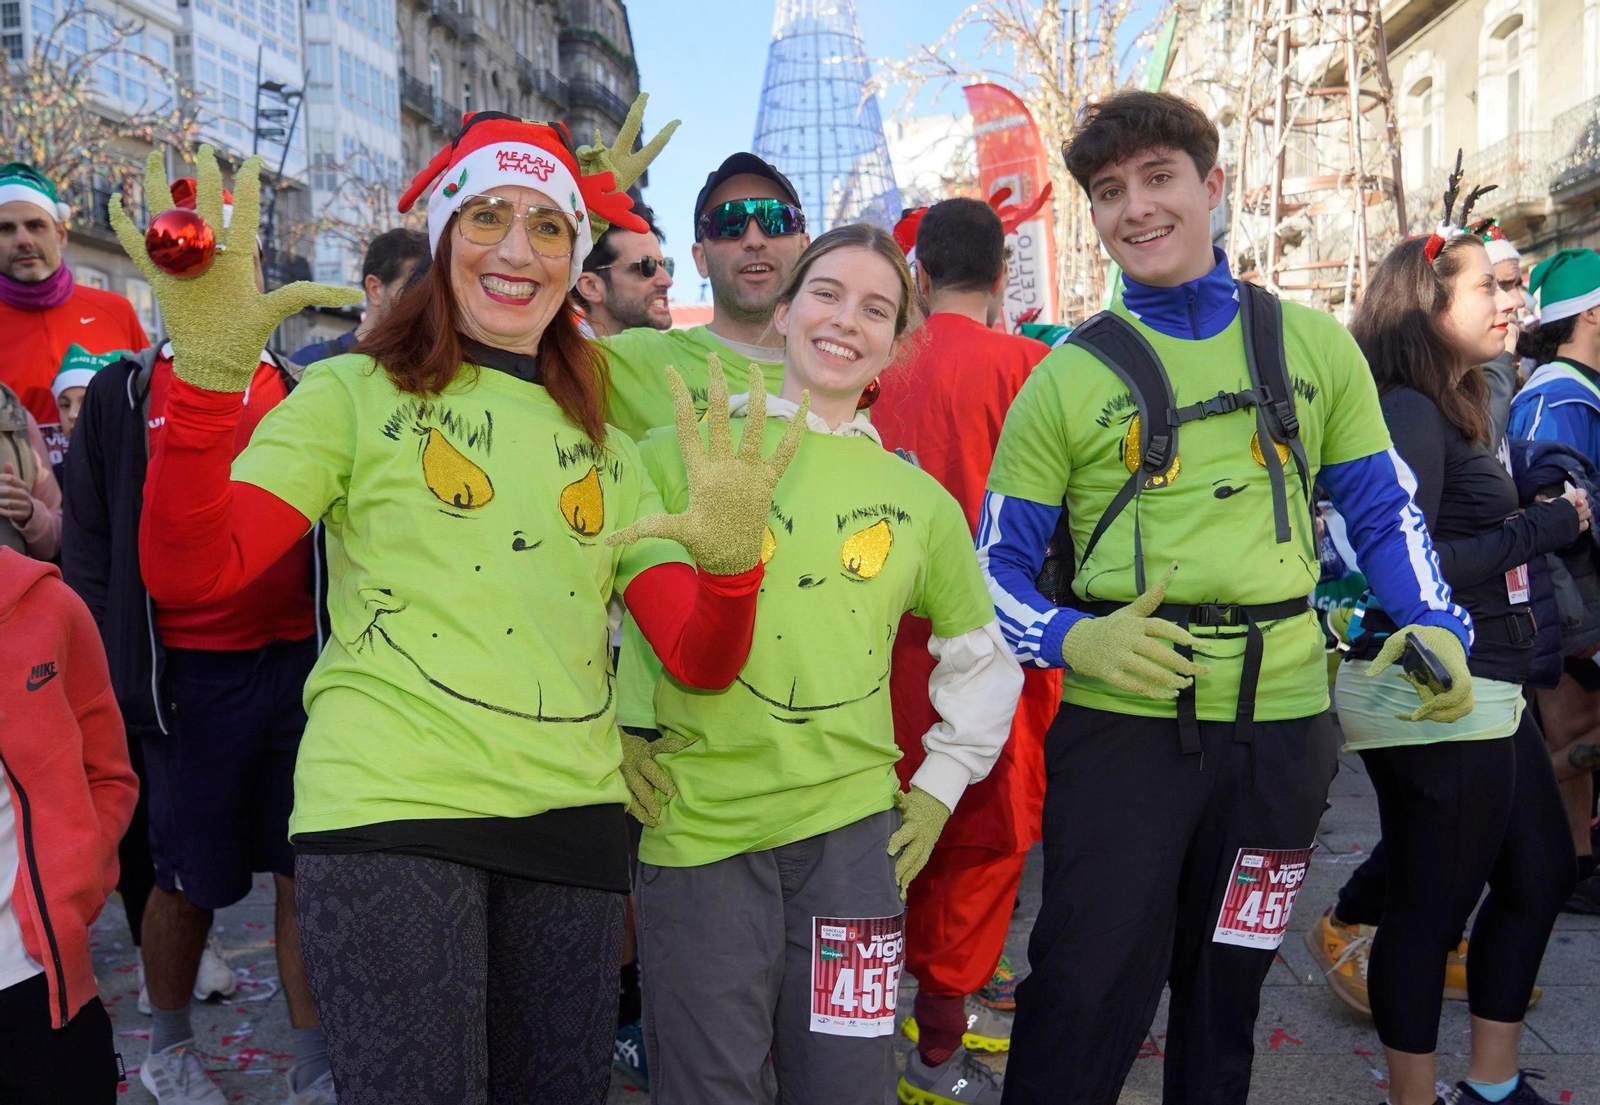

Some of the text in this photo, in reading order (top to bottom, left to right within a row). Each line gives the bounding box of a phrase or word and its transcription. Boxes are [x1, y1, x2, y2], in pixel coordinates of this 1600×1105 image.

[496, 149, 555, 173] MERRY
[31, 661, 55, 679] NIKE
[1269, 868, 1305, 888] vigo
[1237, 890, 1296, 929] 455
[857, 937, 902, 963] vigo
[831, 962, 901, 1013] 455
